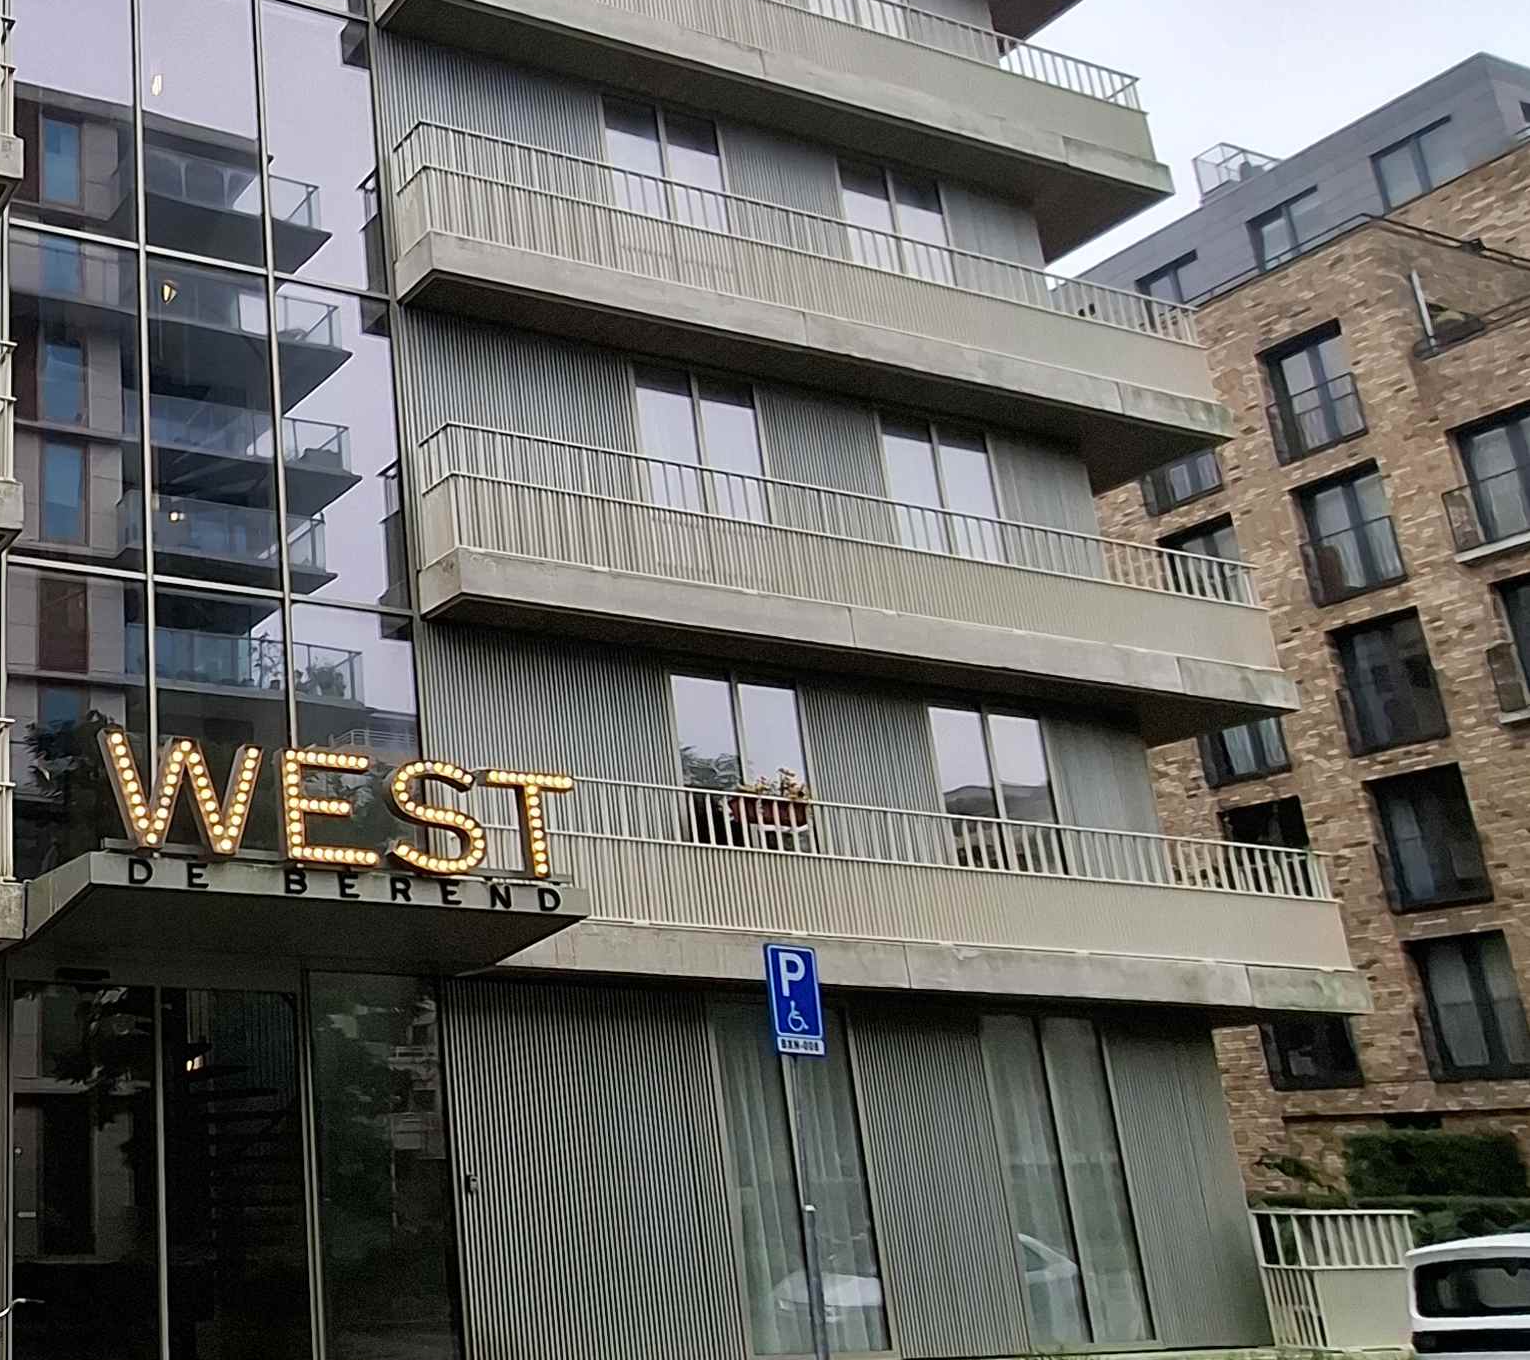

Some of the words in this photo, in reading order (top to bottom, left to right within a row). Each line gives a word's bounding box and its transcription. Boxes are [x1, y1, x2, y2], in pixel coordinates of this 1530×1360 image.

[97, 724, 574, 879] WEST
[128, 858, 210, 889] DE
[284, 870, 562, 913] BEREND
[778, 951, 805, 997] P
